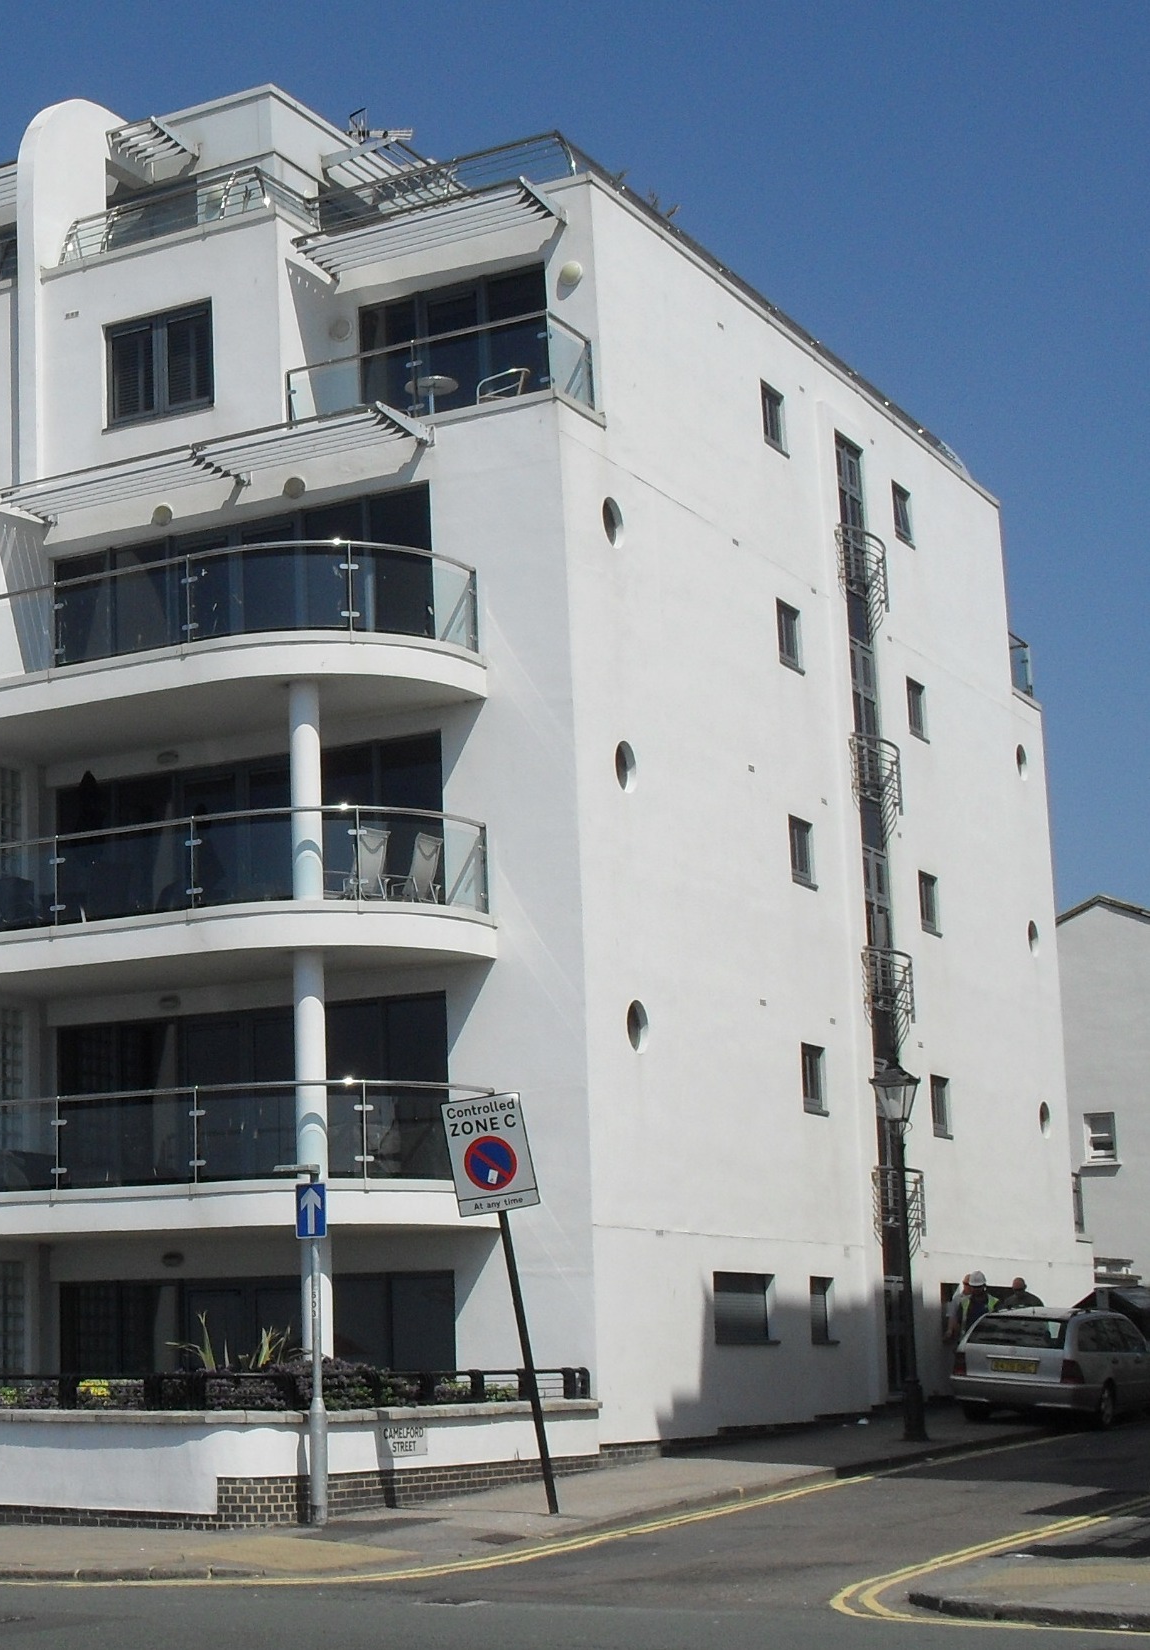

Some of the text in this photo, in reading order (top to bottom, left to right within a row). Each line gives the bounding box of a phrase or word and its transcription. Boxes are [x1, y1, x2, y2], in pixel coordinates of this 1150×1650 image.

[446, 1098, 515, 1119] Controlled
[449, 1114, 517, 1137] ZONE C
[473, 1197, 523, 1211] At any time
[383, 1426, 424, 1439] CAMELFORD
[392, 1440, 417, 1452] STREET
